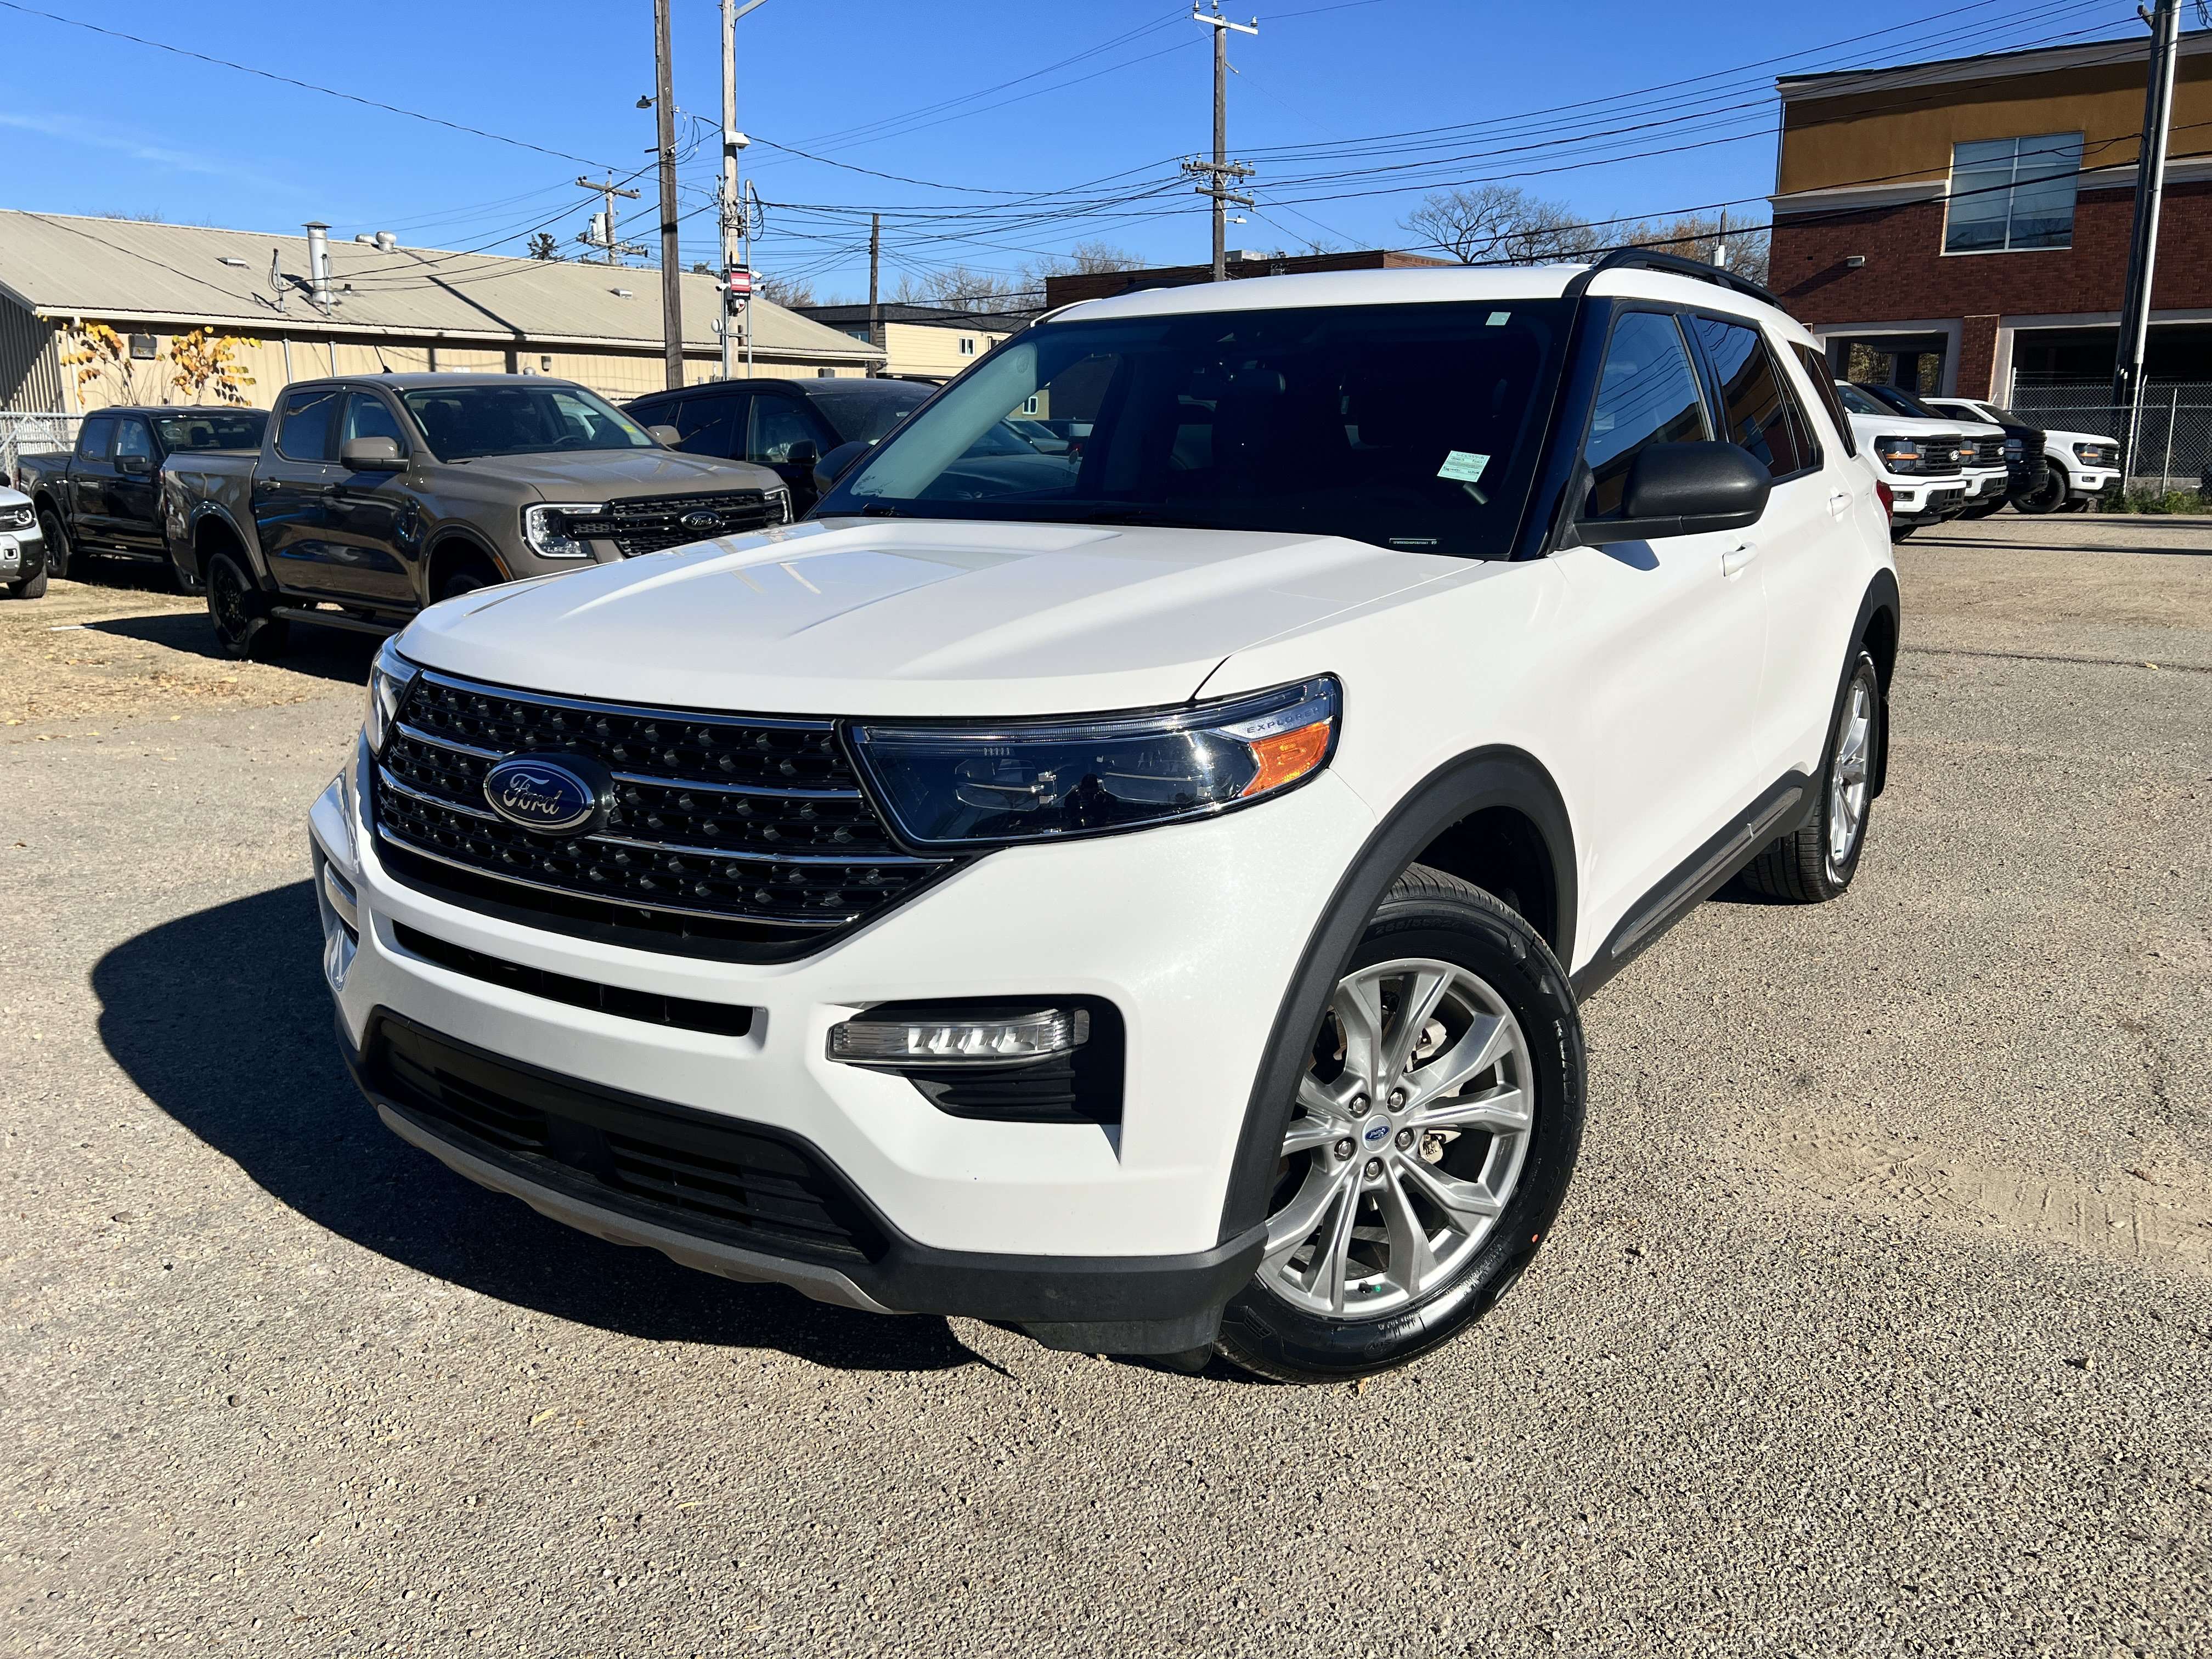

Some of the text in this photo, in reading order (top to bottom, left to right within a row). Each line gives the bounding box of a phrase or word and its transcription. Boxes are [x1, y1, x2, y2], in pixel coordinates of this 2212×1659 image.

[691, 516, 712, 526] Ford
[1246, 707, 1319, 733] EXPLORER
[503, 773, 562, 815] Ford
